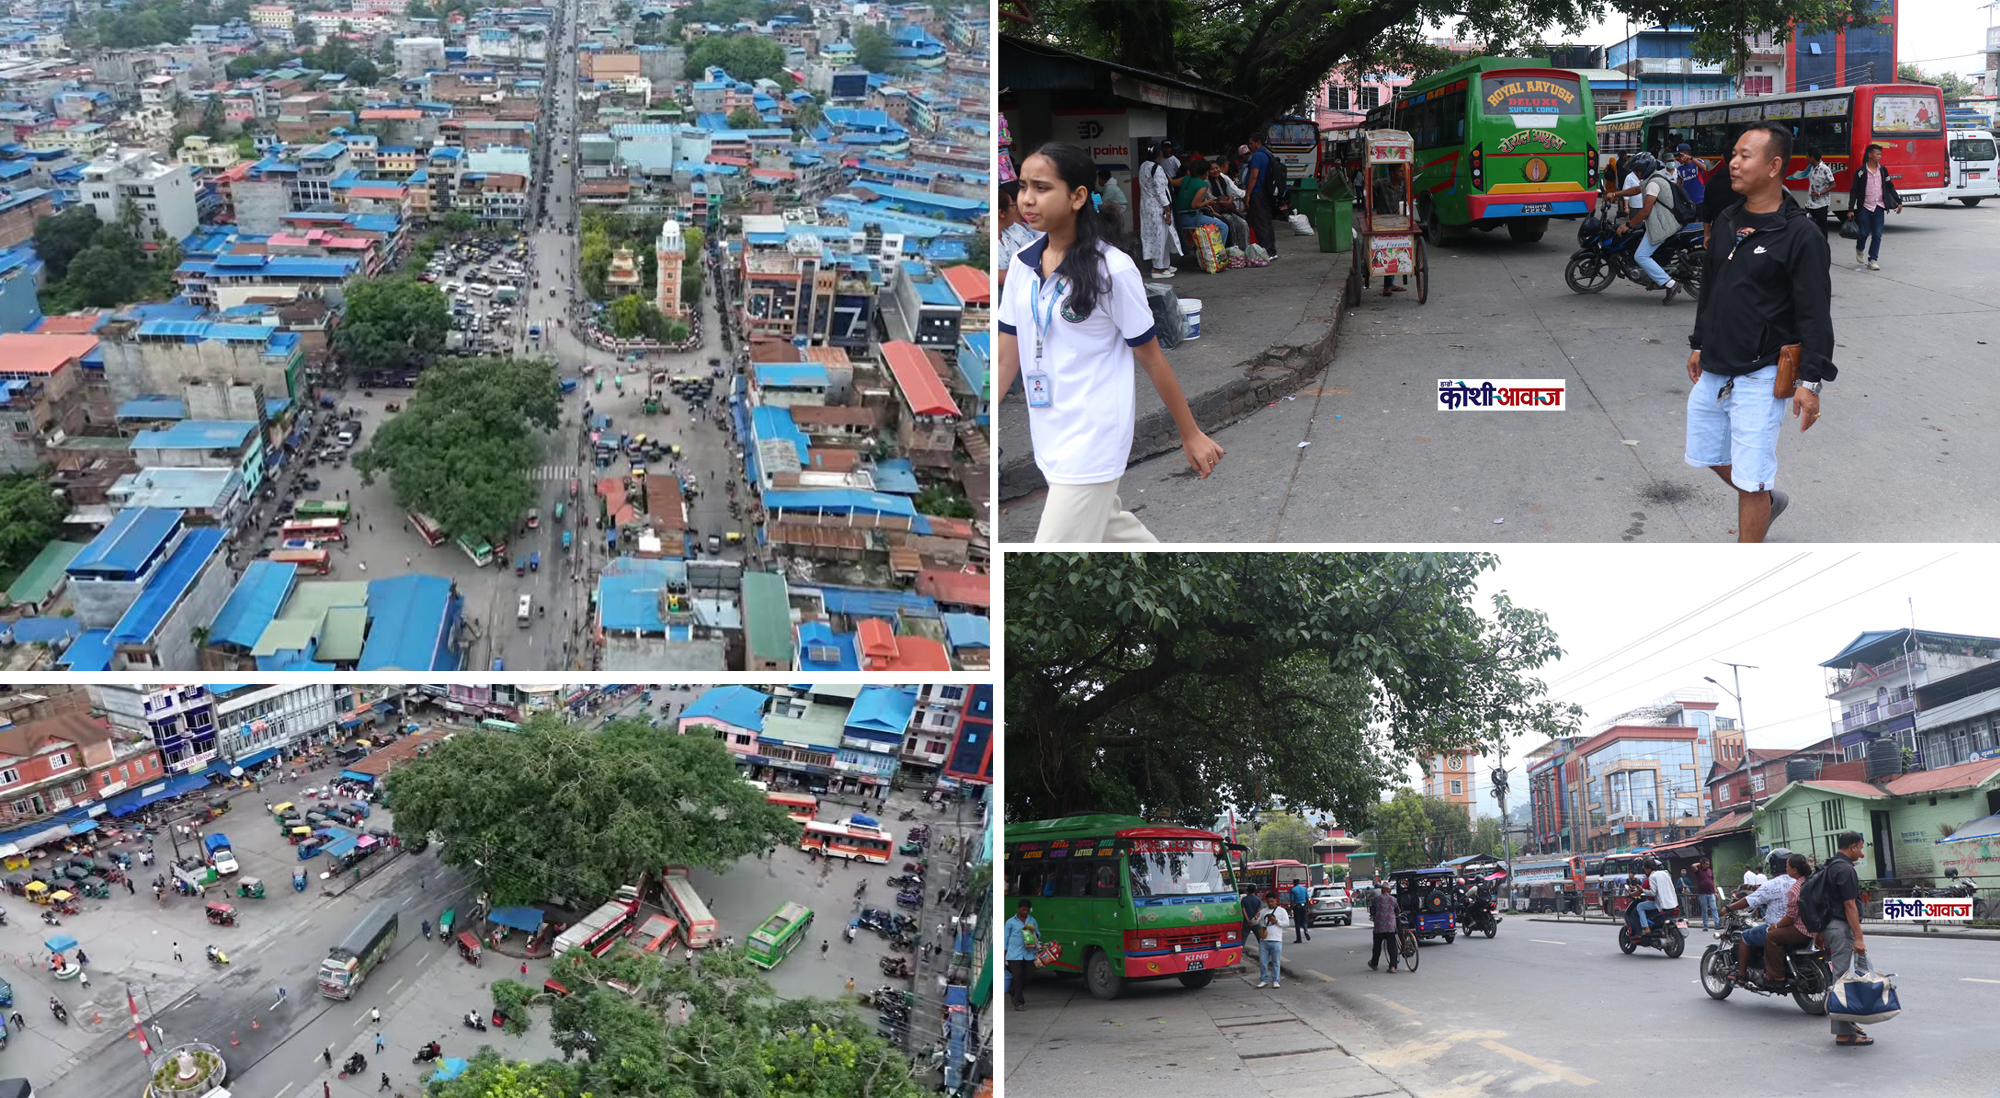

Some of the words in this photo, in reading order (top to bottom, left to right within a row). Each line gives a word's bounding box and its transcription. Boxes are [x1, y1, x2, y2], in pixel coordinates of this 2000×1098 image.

[1487, 82, 1525, 107] ROYAL
[1526, 80, 1575, 104] AAYUSH
[1508, 98, 1558, 106] DELUXE
[1498, 129, 1531, 153] रोयल
[1093, 144, 1128, 159] paints
[1051, 840, 1070, 849] ROYAL
[1076, 839, 1095, 847] ROYAL
[1185, 953, 1209, 961] KING
